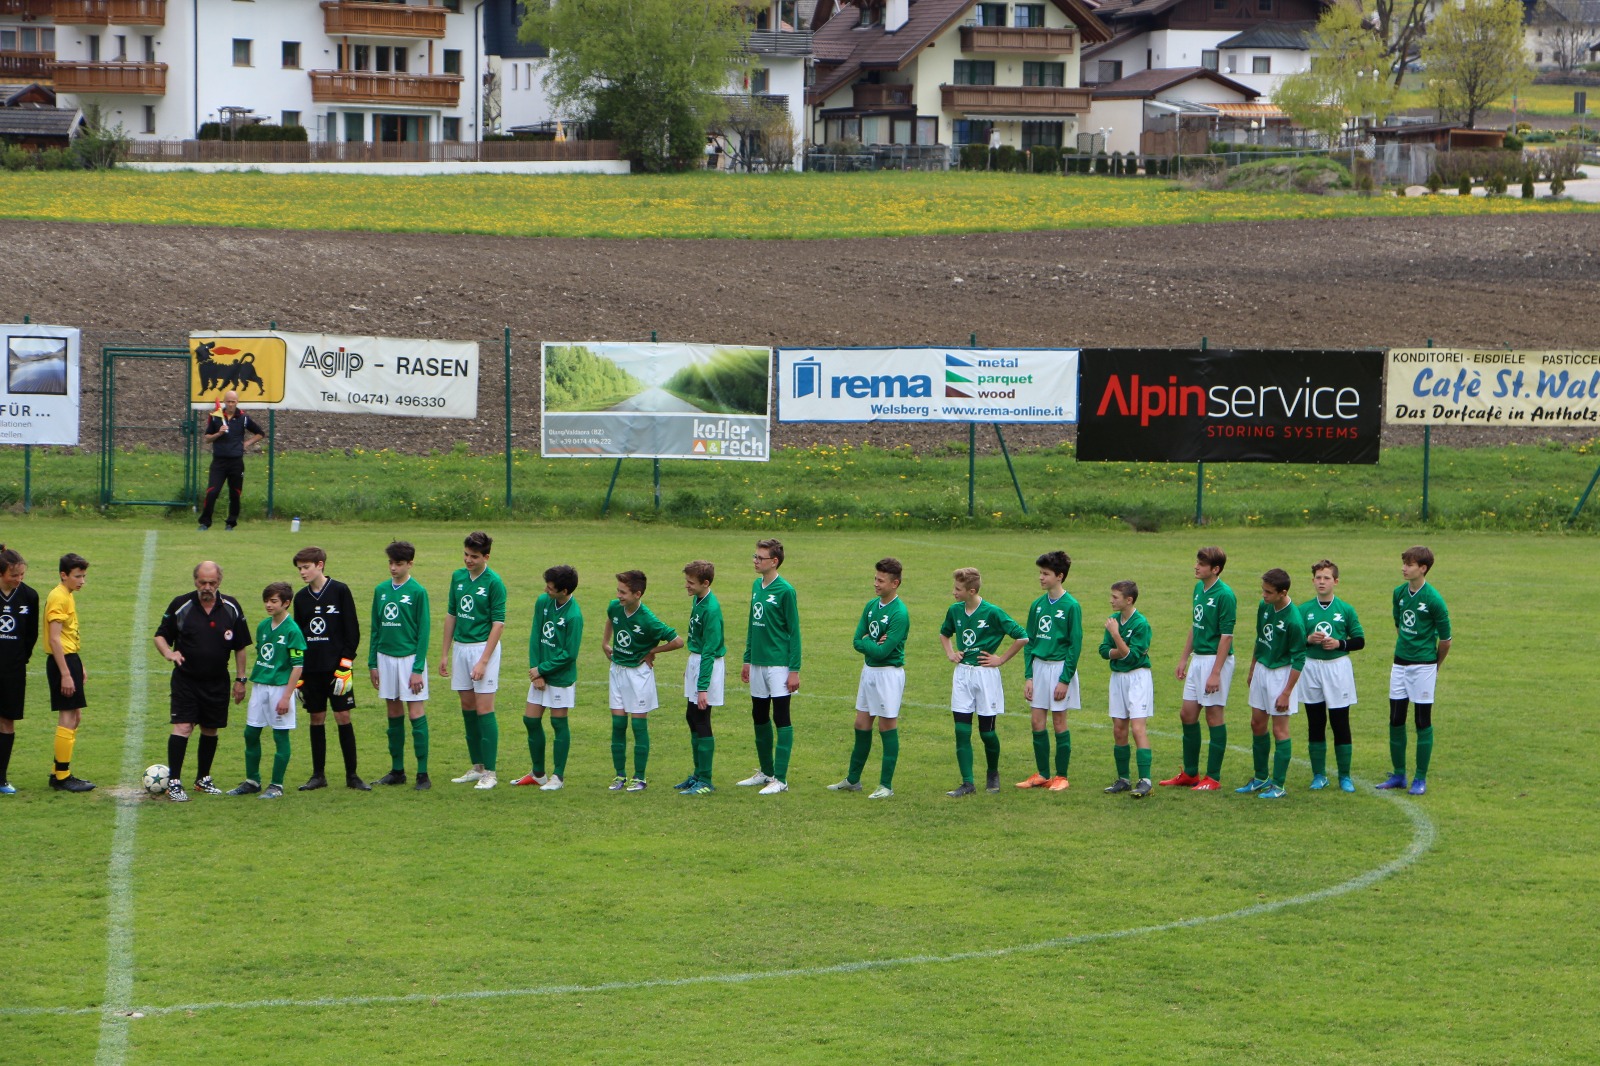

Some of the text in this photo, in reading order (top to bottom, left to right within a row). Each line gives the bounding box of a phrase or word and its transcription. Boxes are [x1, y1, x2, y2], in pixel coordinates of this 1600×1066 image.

[299, 346, 364, 378] Agip
[396, 356, 469, 377] RASEN
[978, 358, 1019, 368] metal
[1393, 352, 1463, 363] KONDITOREI
[1473, 353, 1526, 364] EISDIELE
[1542, 354, 1600, 365] PASTICCE
[831, 375, 933, 399] rema
[977, 373, 1033, 386] parquet
[1412, 367, 1482, 404] Cafè
[320, 391, 446, 408] Tel. (0474) 496330
[977, 389, 1016, 399] wood
[870, 404, 929, 417] Welsberg
[942, 406, 1063, 416] www.rema-online.it
[1395, 404, 1426, 419] Das
[1432, 404, 1503, 422] Dorfcafè
[1508, 406, 1525, 420] in
[0, 420, 32, 428] lationen
[693, 419, 750, 440] kofler
[1207, 425, 1359, 439] STORING SYSTEMS
[720, 436, 763, 456] rech
